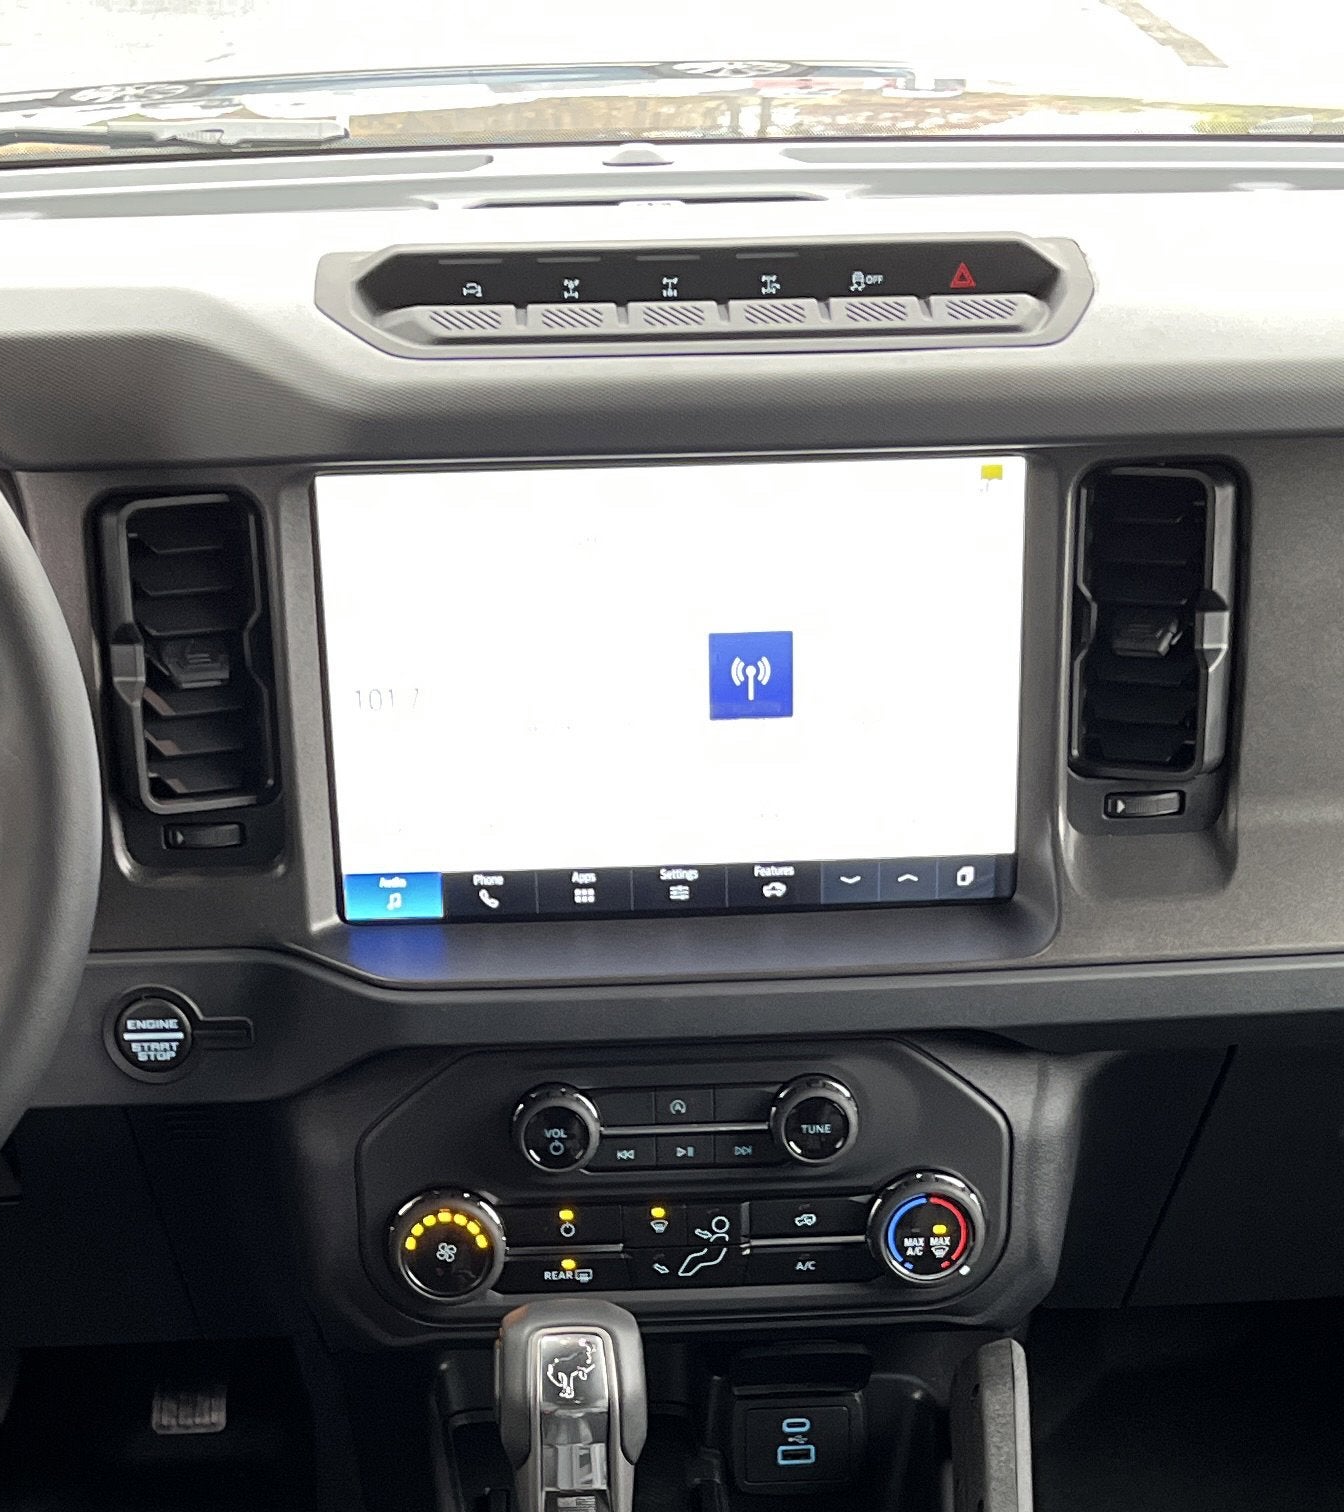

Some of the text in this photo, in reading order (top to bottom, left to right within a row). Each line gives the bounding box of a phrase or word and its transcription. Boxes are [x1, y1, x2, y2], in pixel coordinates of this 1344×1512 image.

[866, 275, 883, 284] OFF
[659, 868, 699, 881] Settings
[754, 865, 795, 877] Features
[378, 877, 407, 888] Audio
[472, 874, 504, 886] Phone
[571, 871, 597, 884] Apps
[126, 1019, 179, 1030] ENGINE
[131, 1041, 179, 1052] START
[137, 1051, 176, 1061] STOP
[544, 1128, 568, 1139] VOL
[801, 1124, 832, 1134] TUNE
[904, 1237, 924, 1248] MAX
[929, 1236, 951, 1246] MAX
[906, 1246, 923, 1257] A/C
[795, 1260, 816, 1271] A/C
[544, 1270, 574, 1281] REAR
